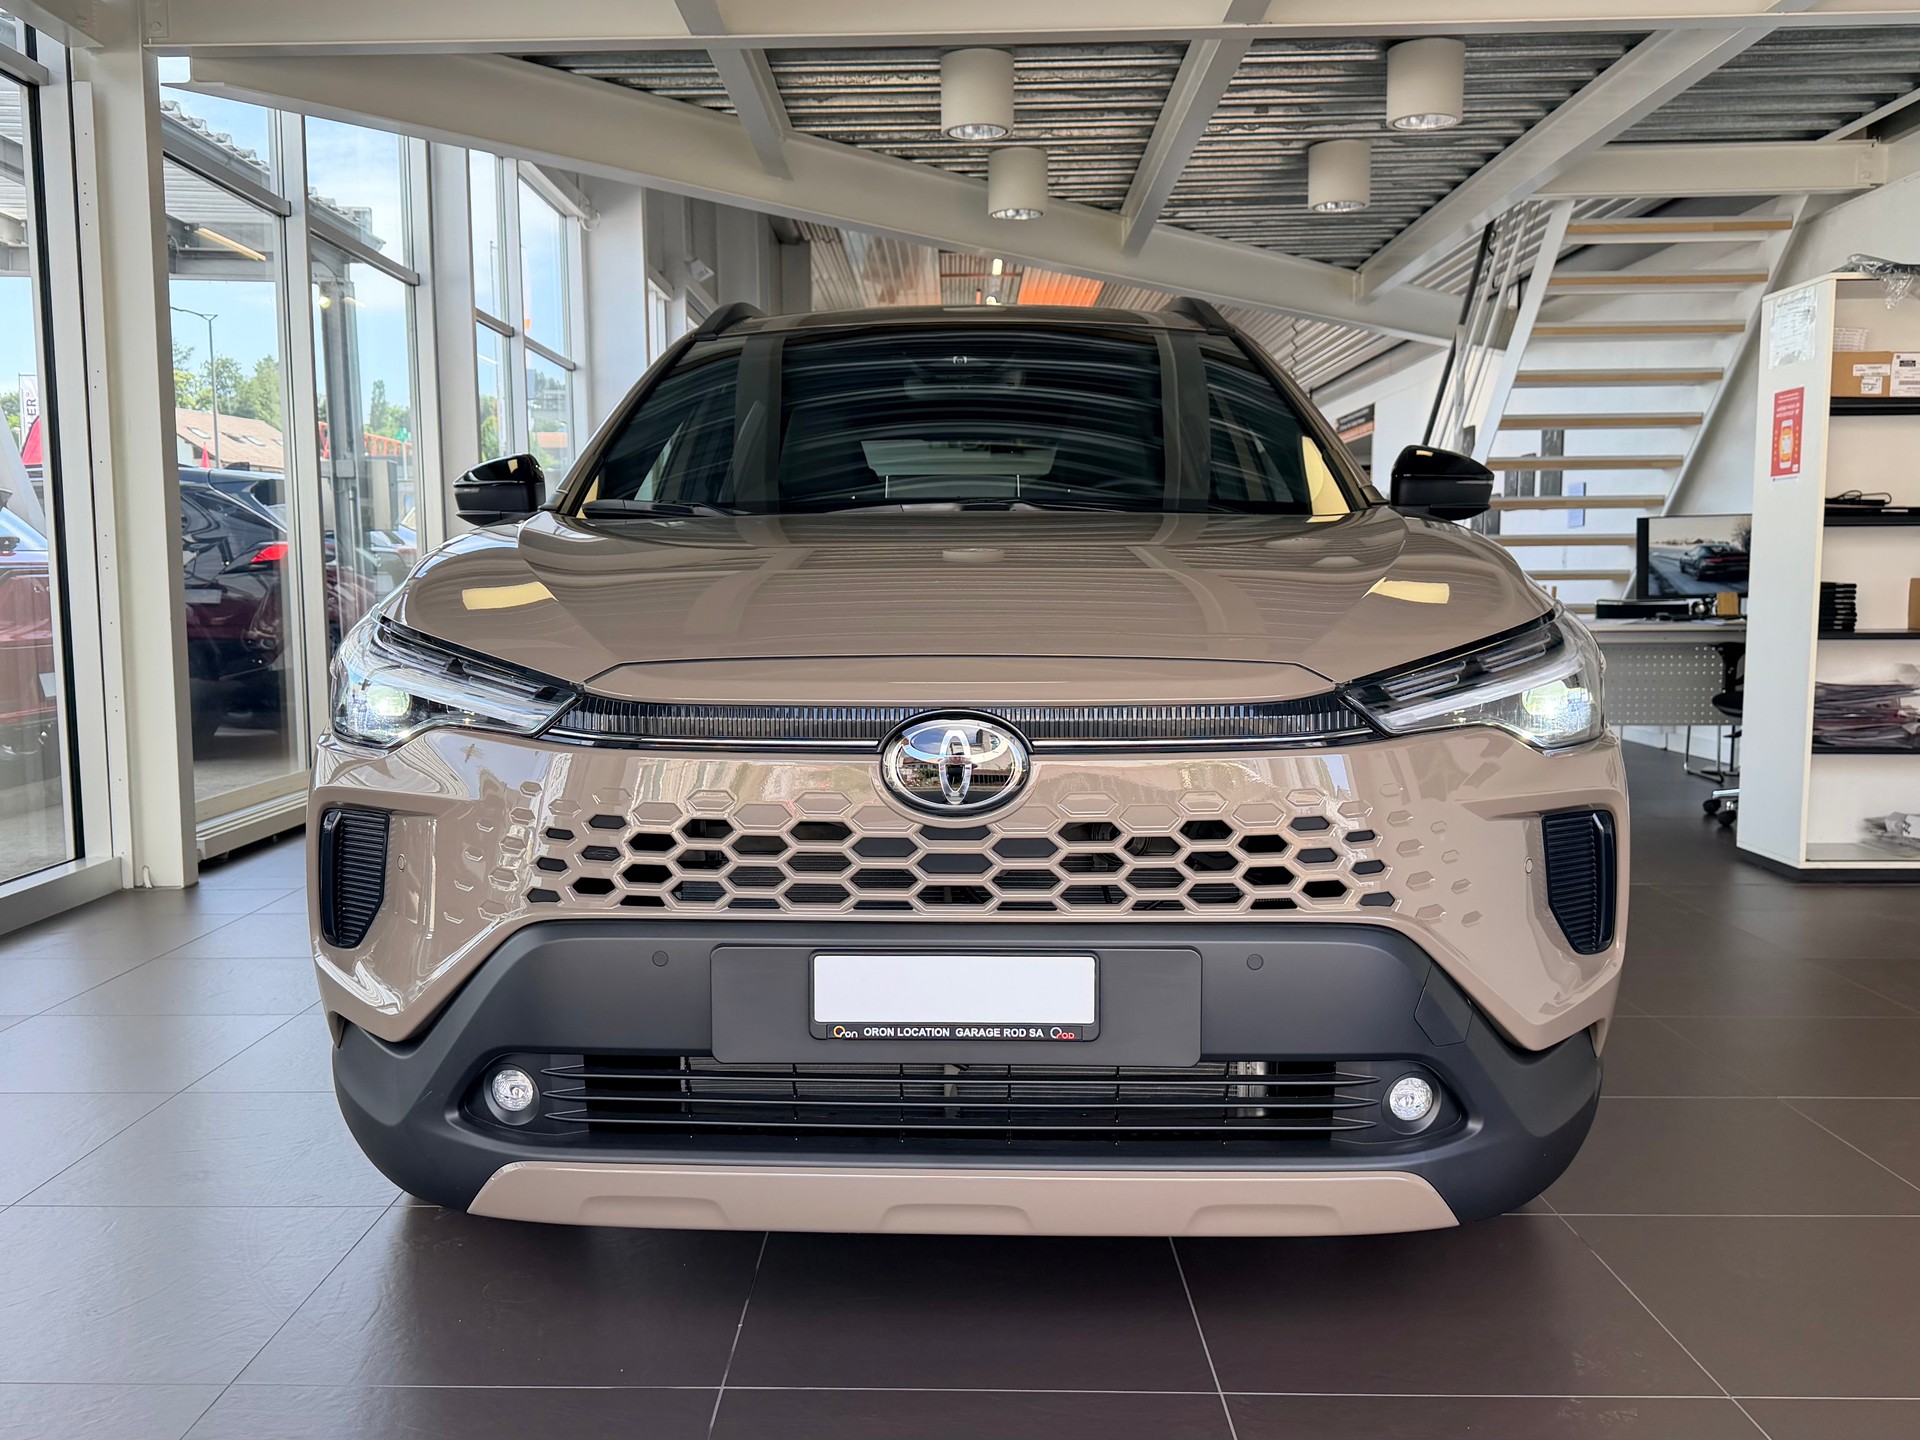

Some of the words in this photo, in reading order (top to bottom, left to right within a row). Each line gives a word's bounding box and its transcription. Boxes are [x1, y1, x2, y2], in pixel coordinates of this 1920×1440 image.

[863, 1027, 895, 1037] ORON
[897, 1027, 950, 1037] LOCATION
[955, 1028, 1001, 1037] GARAGE
[1003, 1028, 1027, 1038] ROD
[1029, 1028, 1044, 1038] SA
